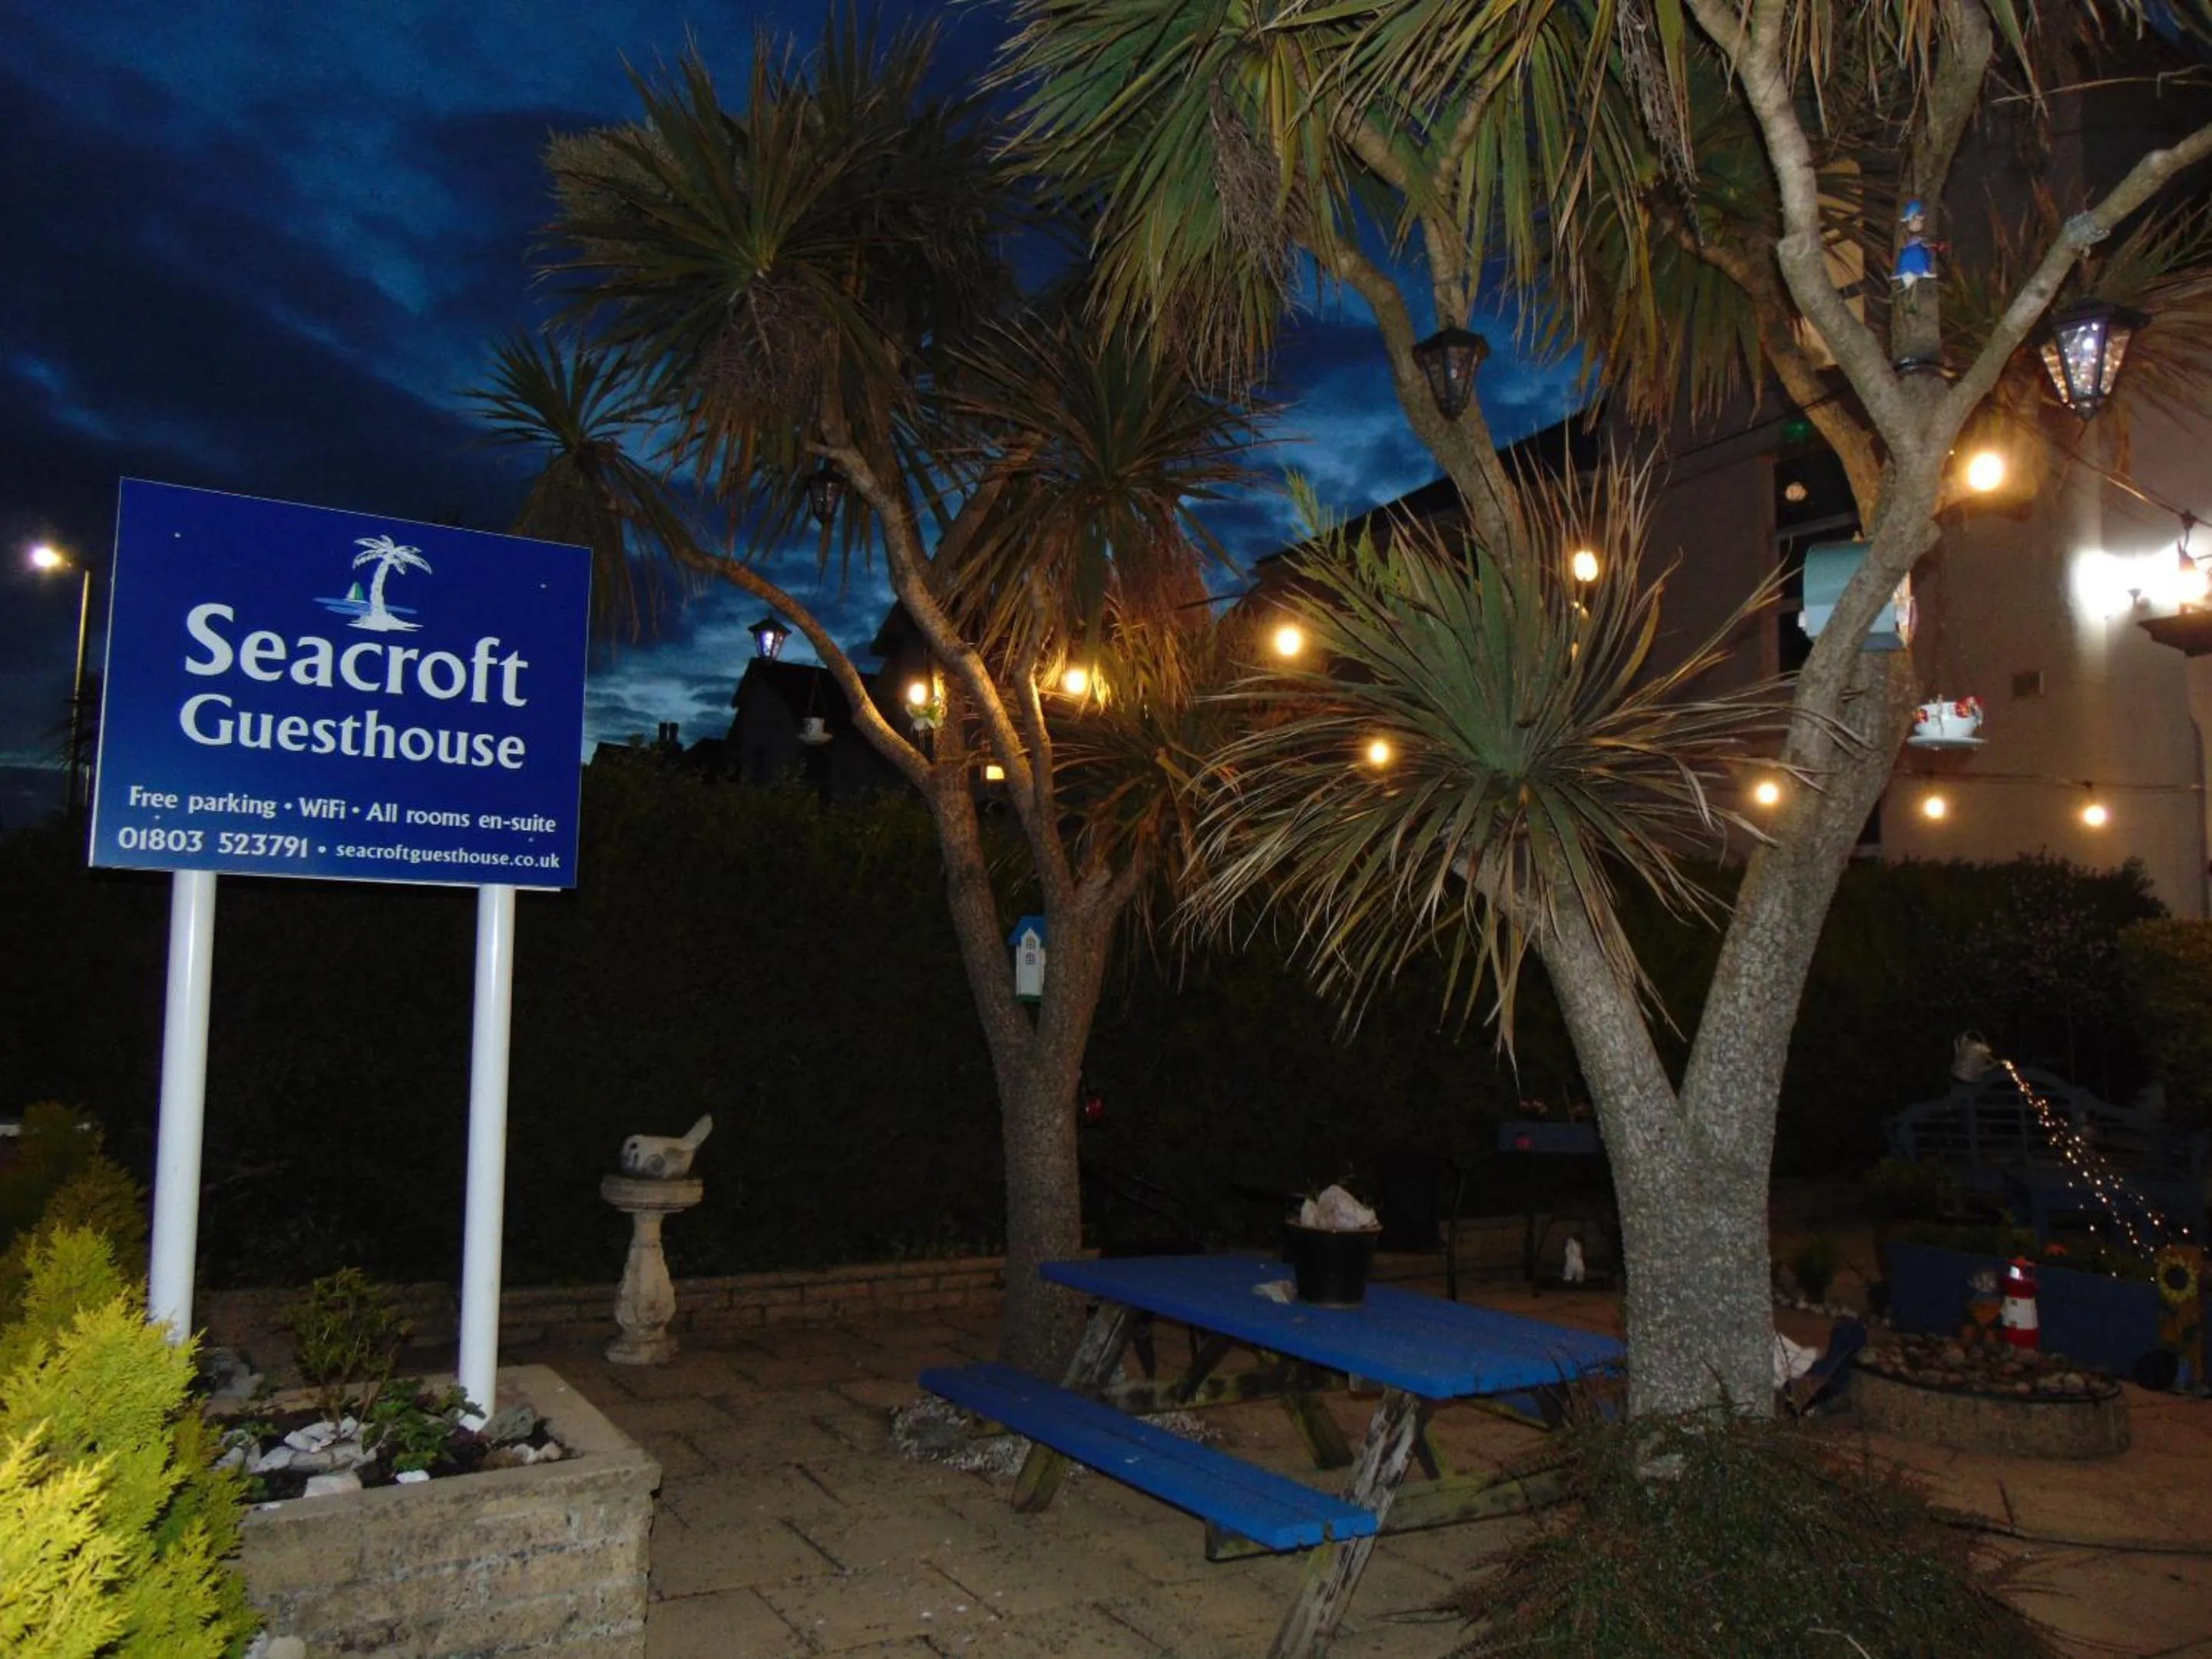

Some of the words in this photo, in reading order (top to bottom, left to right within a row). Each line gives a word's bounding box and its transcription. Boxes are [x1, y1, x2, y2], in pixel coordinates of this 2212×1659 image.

[184, 603, 530, 708] Seacroft
[179, 693, 527, 770] Guesthouse
[129, 785, 178, 809] Free
[187, 792, 276, 819] parking
[299, 797, 346, 820] WiFi
[365, 802, 398, 823] All
[405, 809, 471, 828] rooms
[478, 814, 557, 833] en-suite
[117, 826, 204, 853] 01803
[217, 831, 308, 858] 523791
[335, 843, 560, 868] seacroftguesthouse.co.uk
